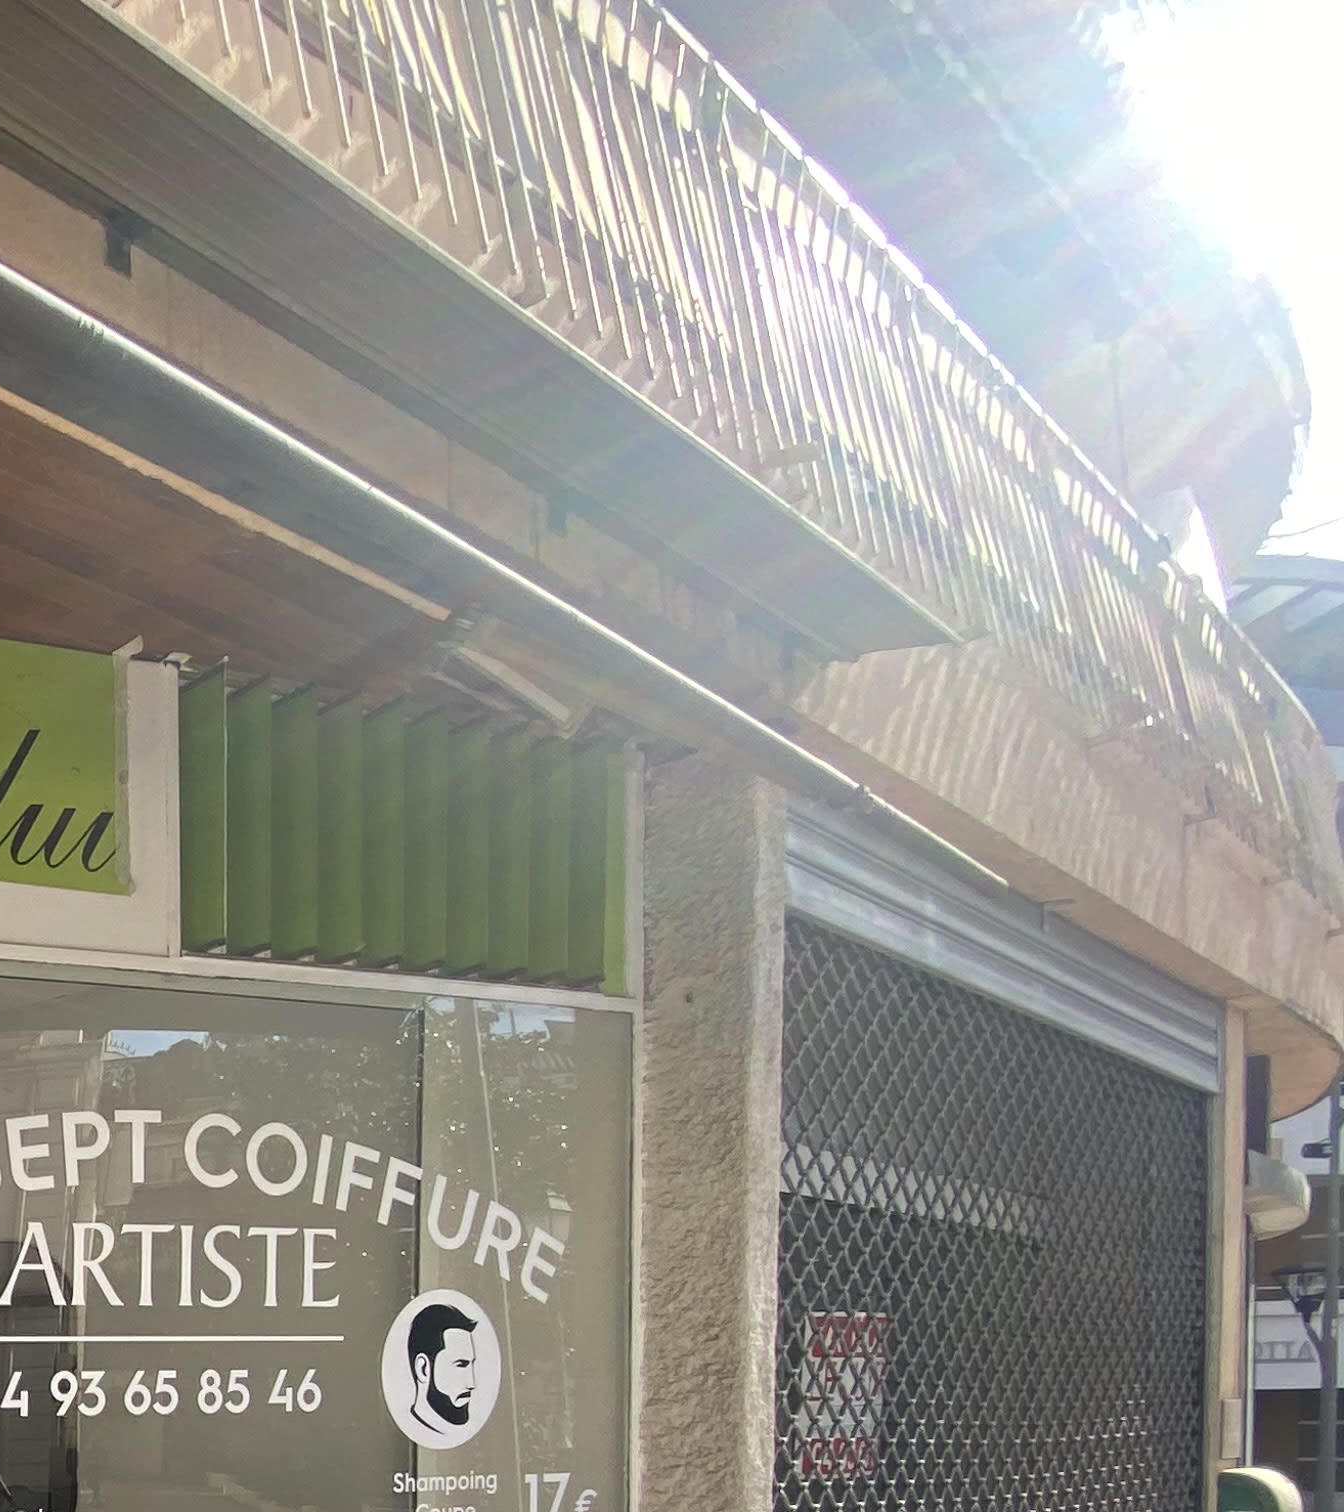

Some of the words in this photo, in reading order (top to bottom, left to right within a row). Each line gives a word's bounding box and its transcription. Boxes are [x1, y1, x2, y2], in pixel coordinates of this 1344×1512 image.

[185, 1112, 566, 1303] COIFFURE
[50, 1369, 106, 1417] 93
[124, 1369, 180, 1416] 65
[198, 1369, 250, 1414] 85
[268, 1368, 321, 1412] 46
[393, 1471, 497, 1493] Shampoing
